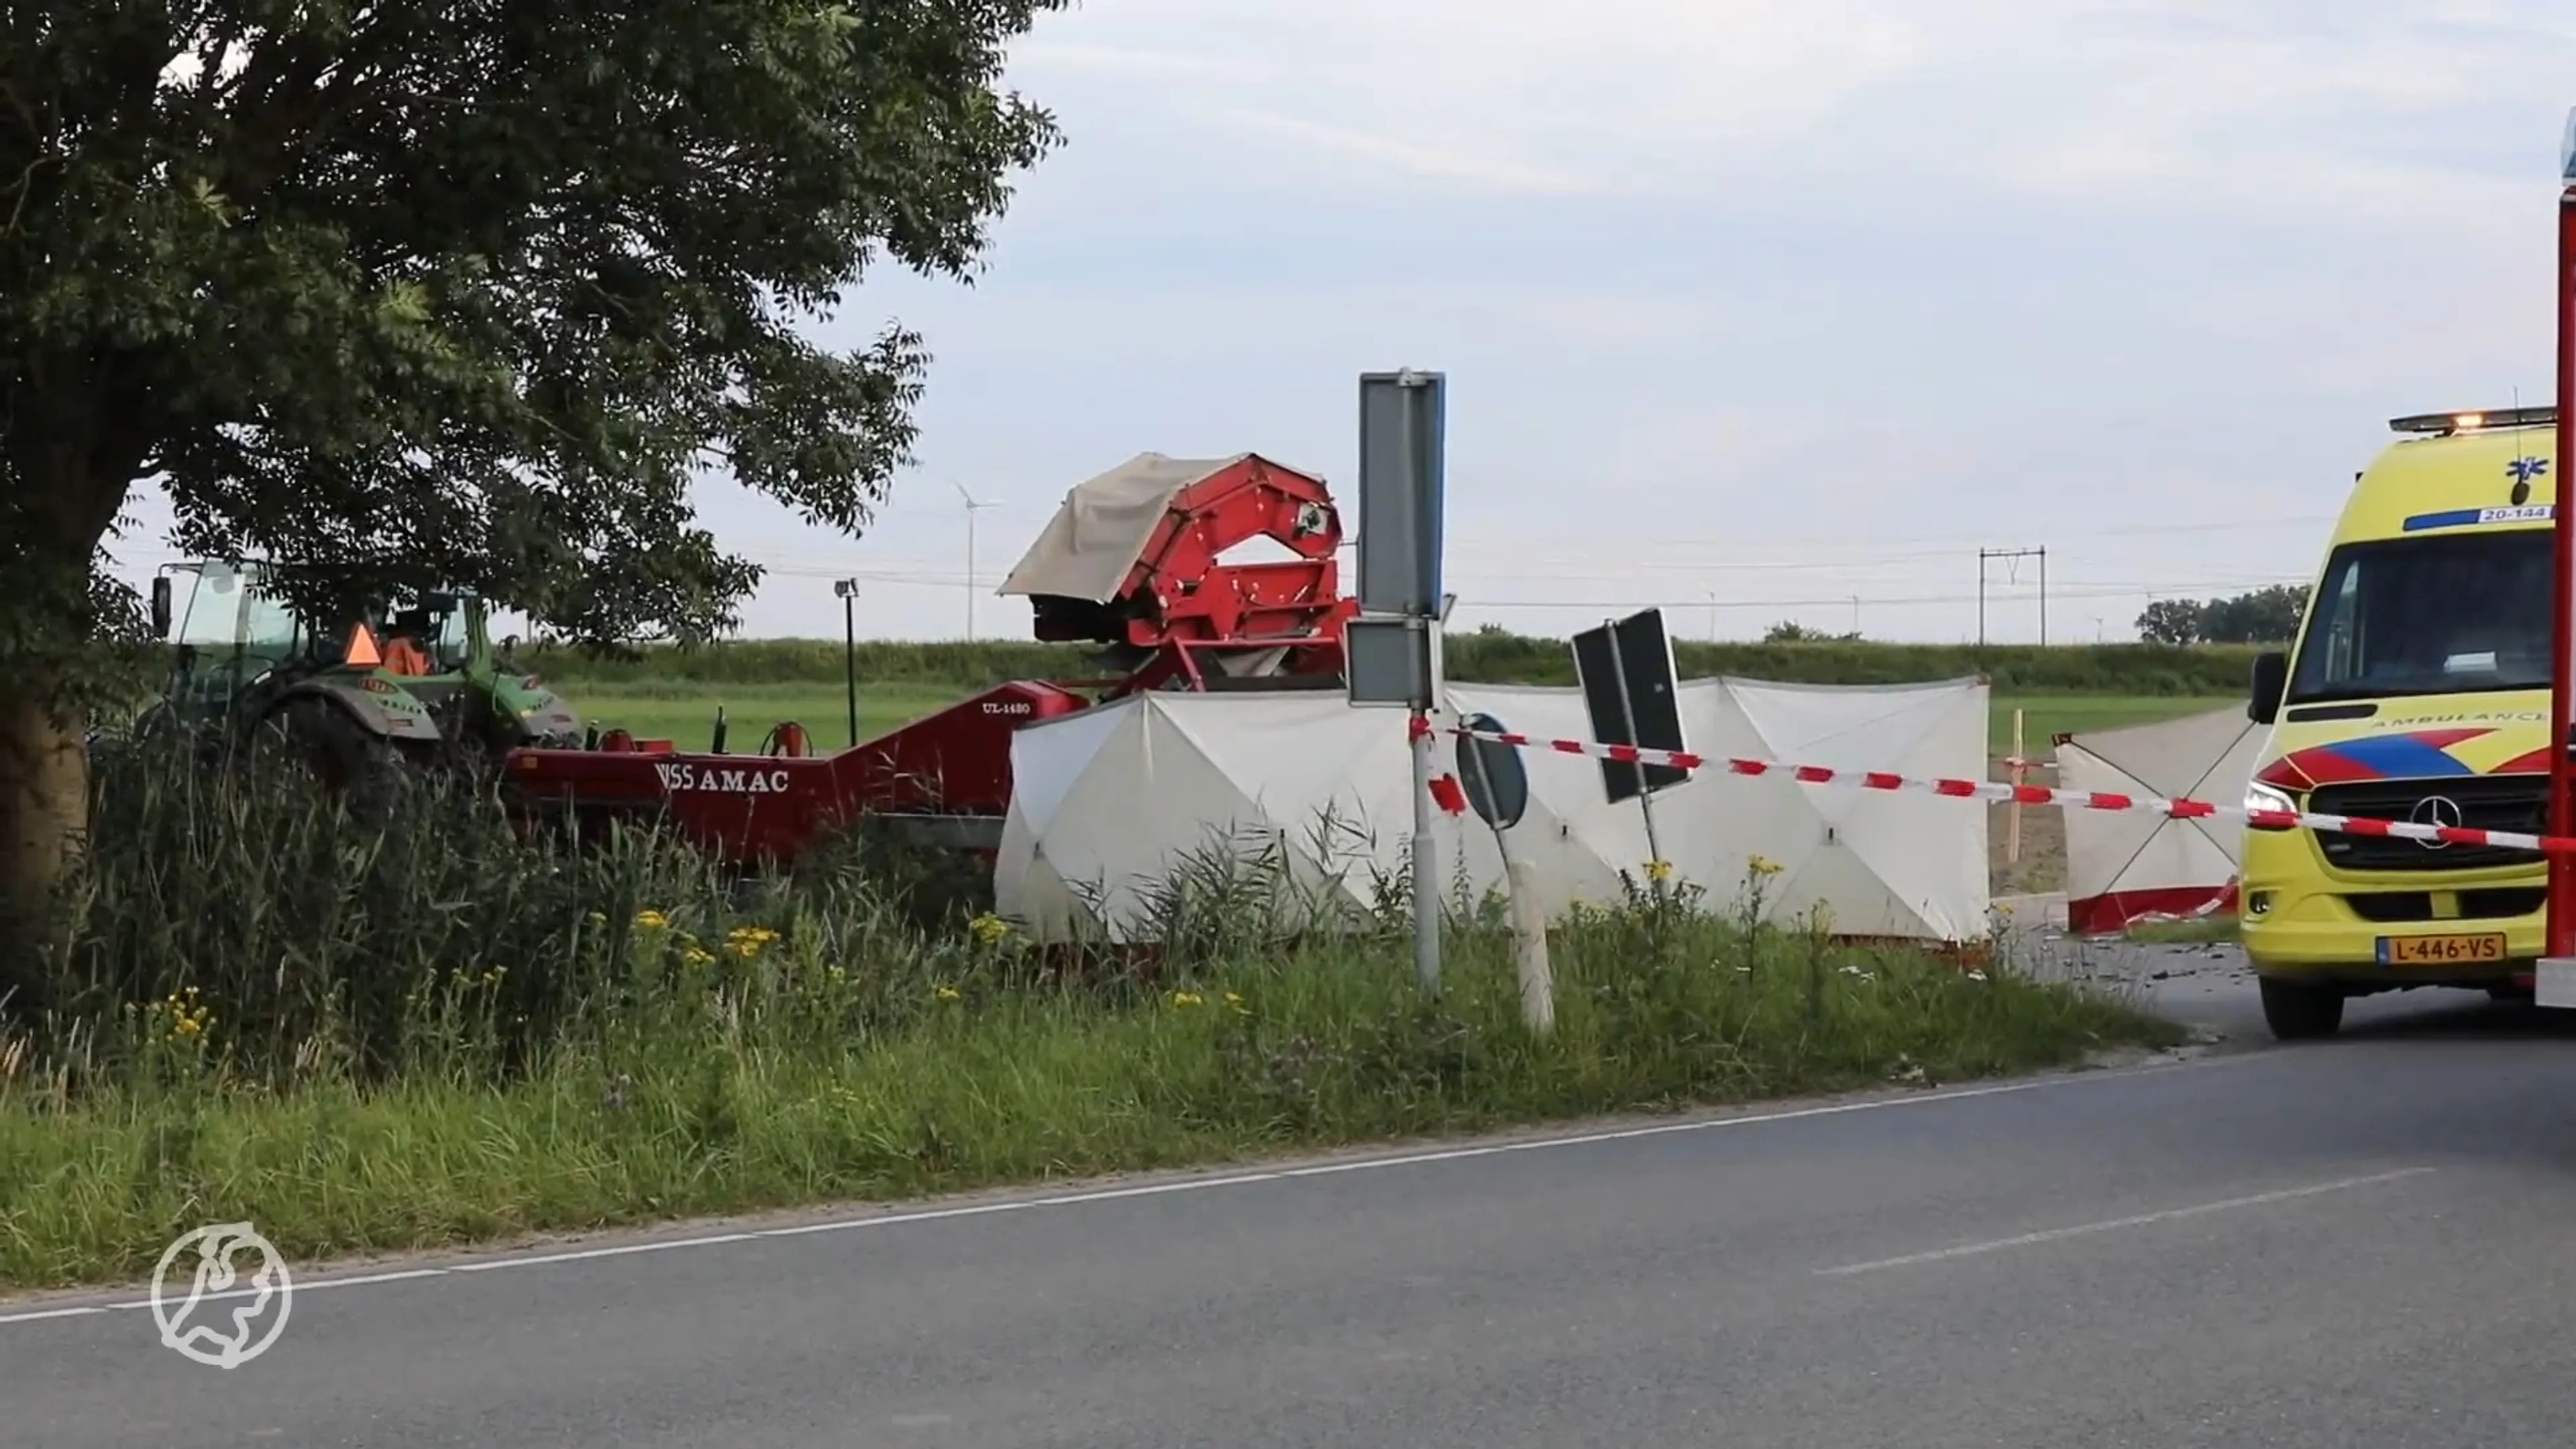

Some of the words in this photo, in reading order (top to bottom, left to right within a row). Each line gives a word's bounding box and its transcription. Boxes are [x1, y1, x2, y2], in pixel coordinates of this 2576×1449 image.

[2484, 507, 2544, 521] 20-144
[2371, 712, 2548, 729] AMBULANCE
[699, 769, 789, 792] AMAC
[2396, 938, 2496, 961] L-446-VS
